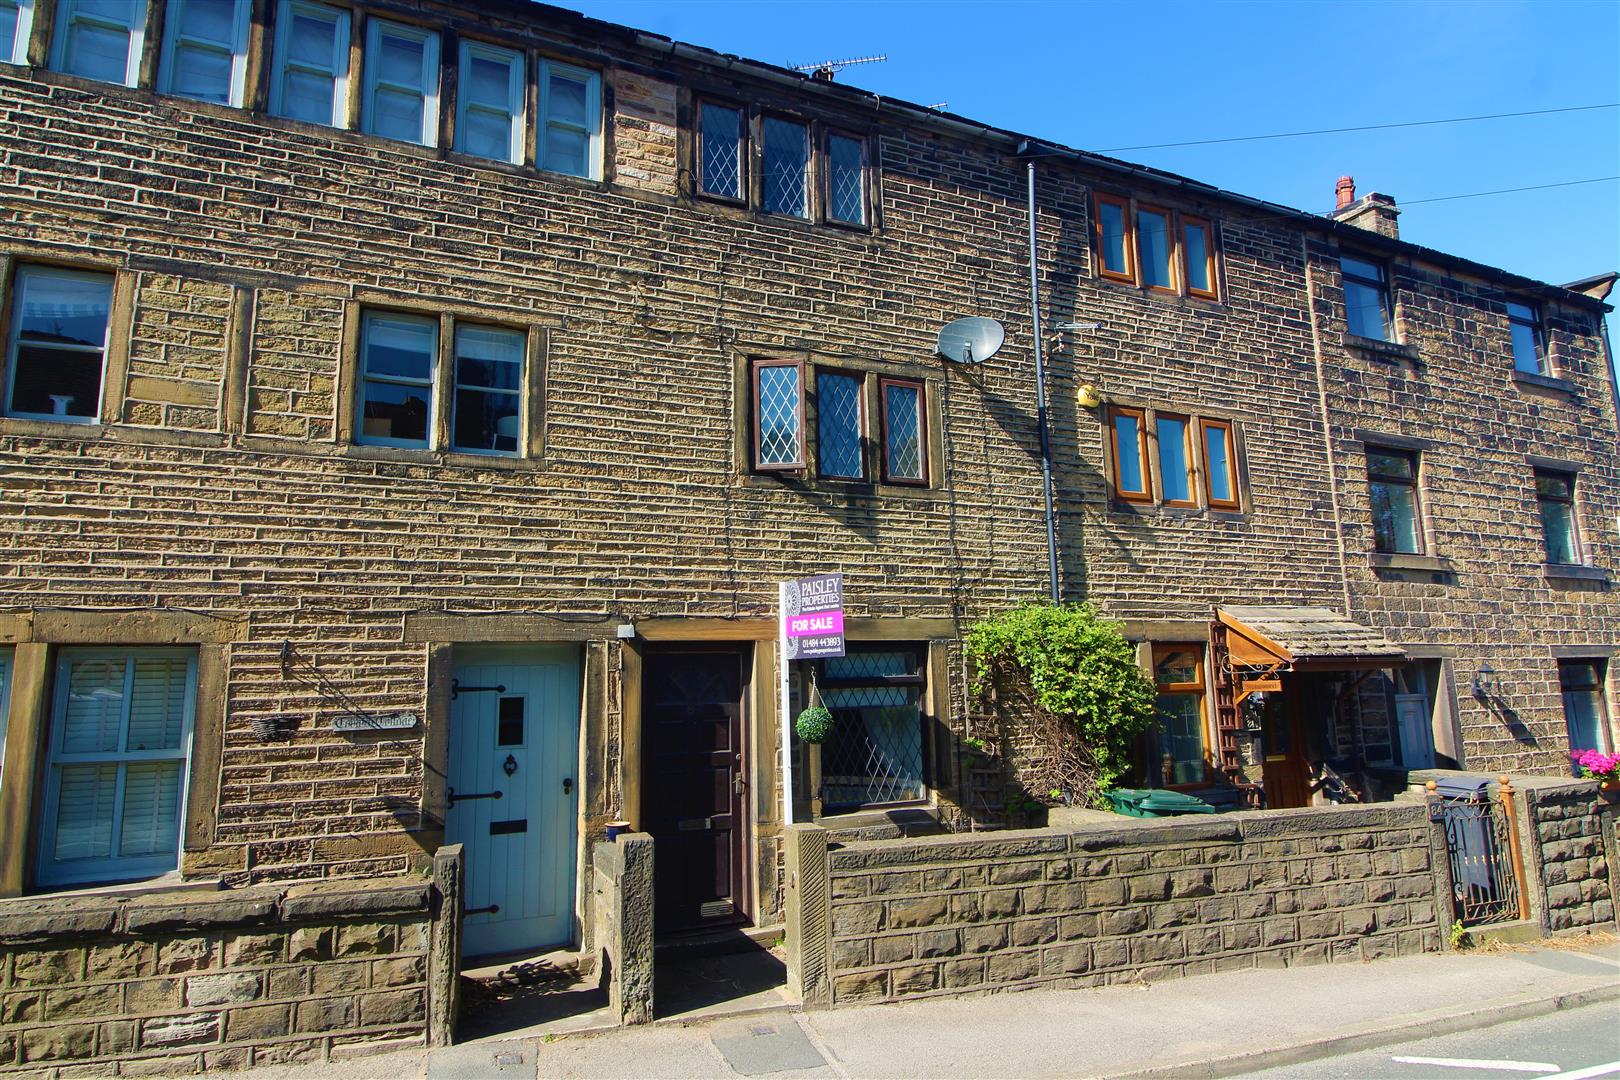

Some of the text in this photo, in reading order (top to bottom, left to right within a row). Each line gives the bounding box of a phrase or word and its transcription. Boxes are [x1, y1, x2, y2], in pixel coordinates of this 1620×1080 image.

[802, 578, 840, 597] PAISLEY
[802, 593, 840, 606] PROPERTIES
[792, 617, 833, 632] FOR SALE
[802, 637, 841, 648] 01484 443893
[1431, 804, 1443, 816] 84
